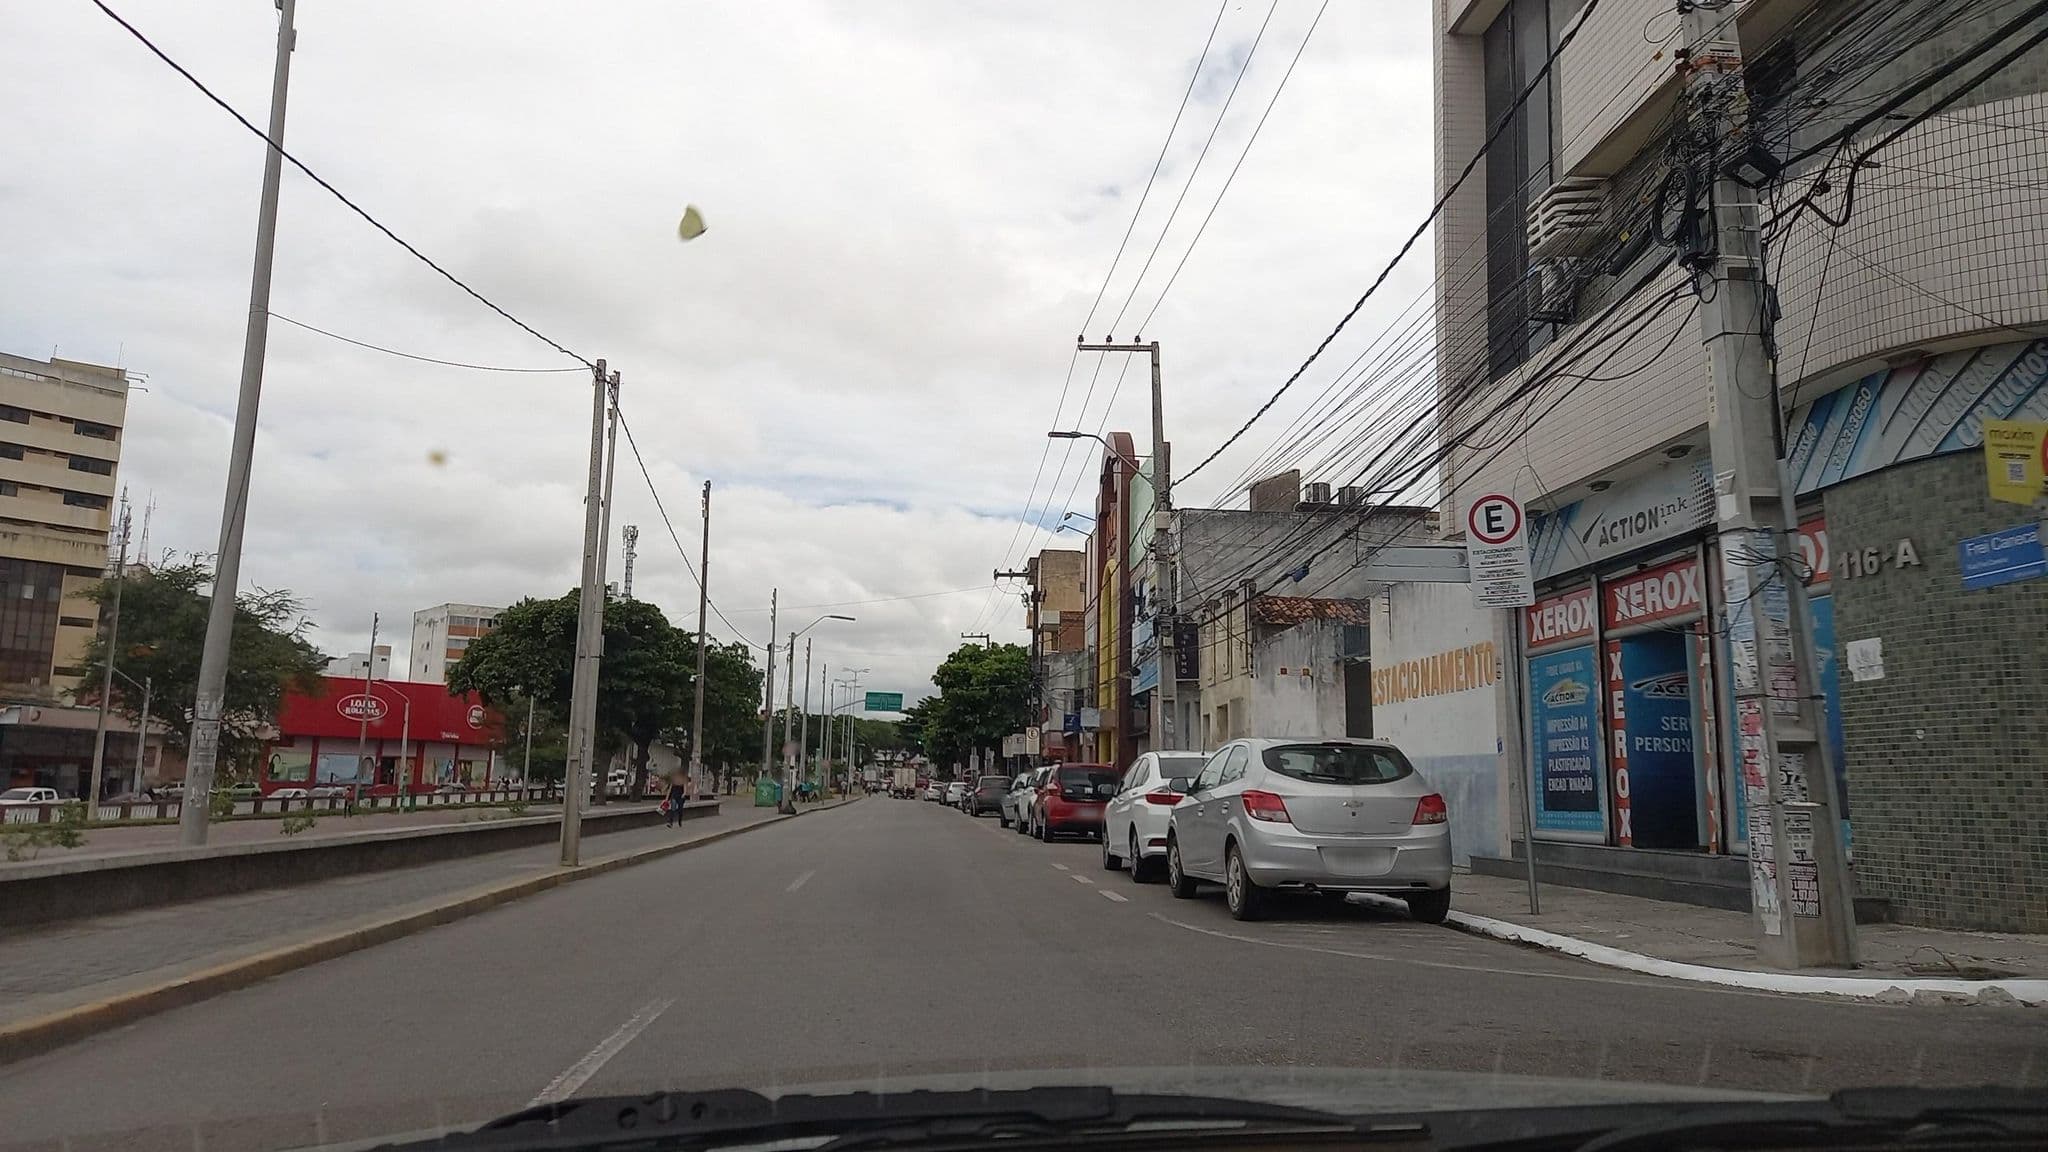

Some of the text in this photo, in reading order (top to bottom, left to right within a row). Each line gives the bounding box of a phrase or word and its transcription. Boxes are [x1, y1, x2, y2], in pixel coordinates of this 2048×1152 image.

[1989, 428, 2035, 441] maxim
[1485, 505, 1505, 533] E
[1598, 505, 1659, 548] ACTION
[1659, 496, 1687, 519] ink
[1838, 538, 1920, 580] 116-A
[1965, 531, 2038, 558] Frei Caneca
[1614, 565, 1700, 621] XEROX
[1530, 594, 1594, 643] XEROX
[1372, 640, 1496, 706] ESTACIONAMENTO
[1551, 691, 1575, 703] ACTION
[1609, 651, 1632, 838] XEROX
[1548, 755, 1591, 774] PLASTIFICAÇÃO
[1548, 774, 1593, 794] ENCADRNAÇÃO
